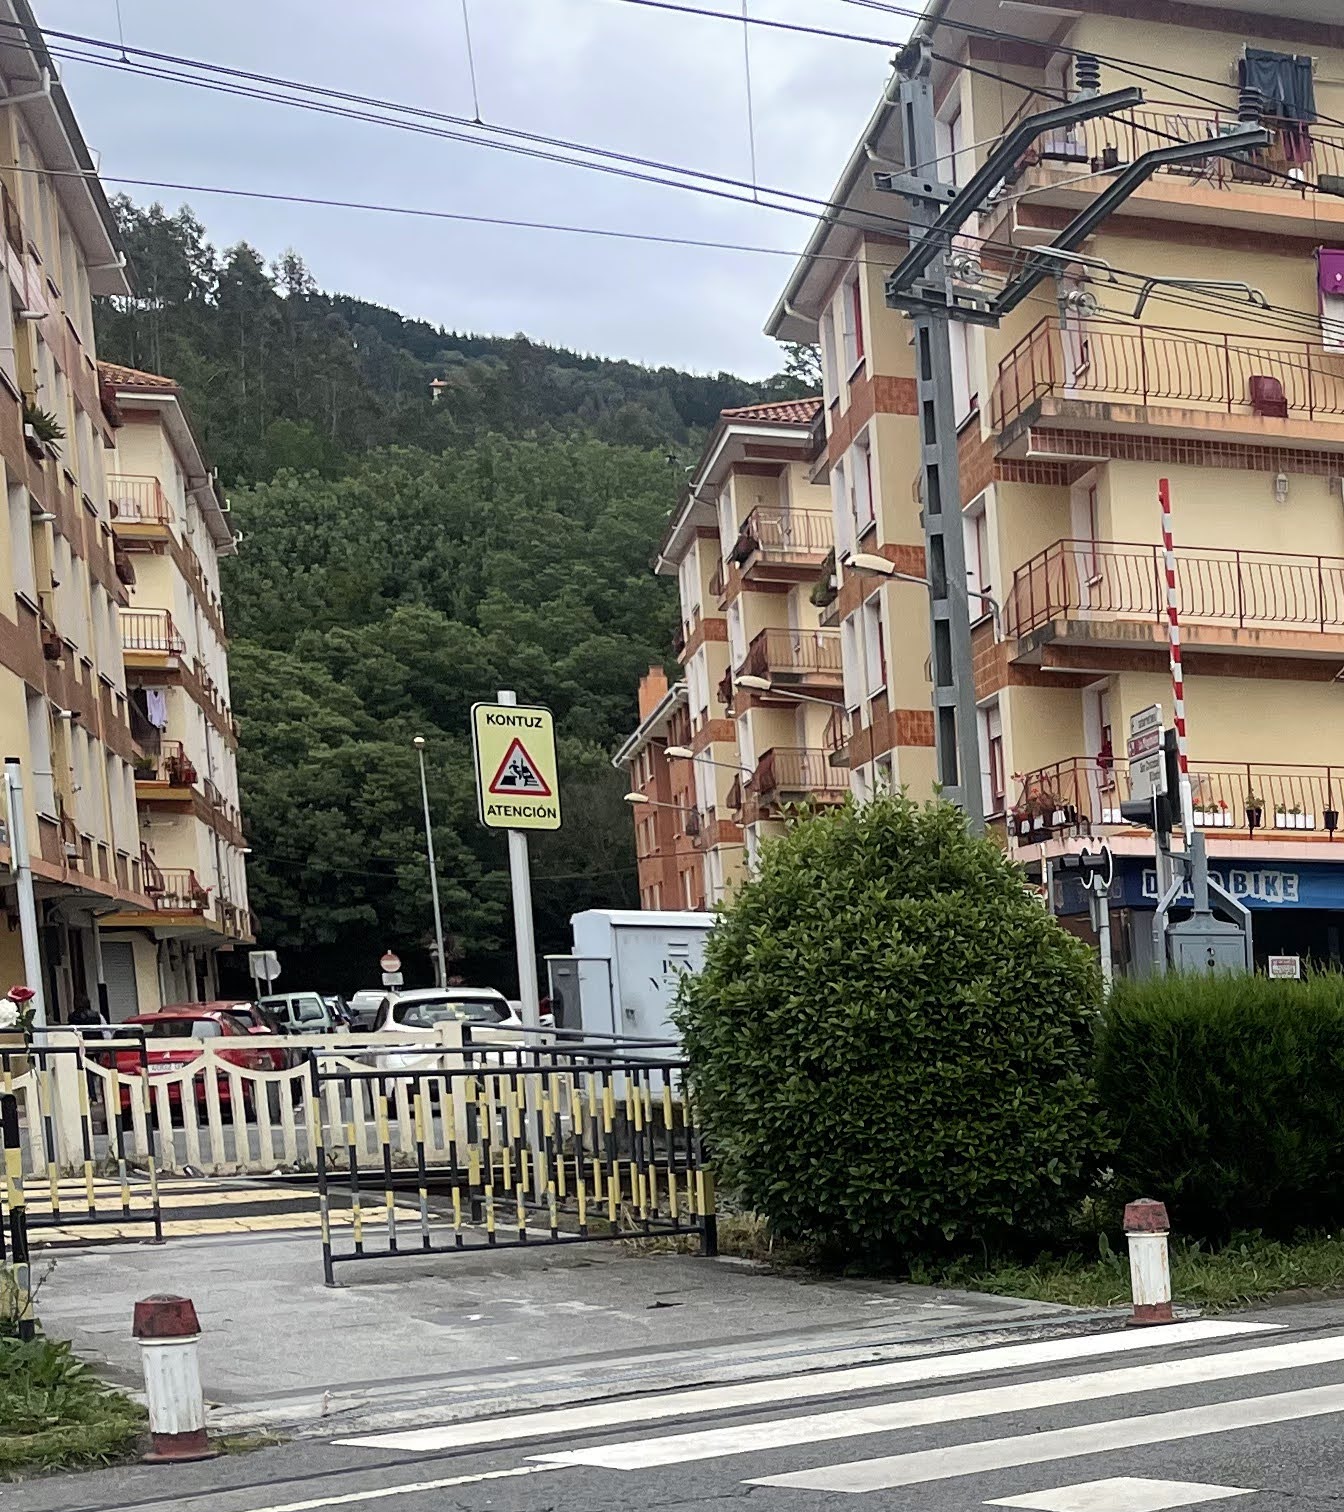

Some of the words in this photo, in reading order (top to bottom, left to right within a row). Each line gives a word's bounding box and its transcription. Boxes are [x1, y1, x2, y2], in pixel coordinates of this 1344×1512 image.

[486, 713, 543, 728] KONTUZ
[487, 804, 557, 819] ATENCIÓN
[1232, 870, 1295, 898] BIKE
